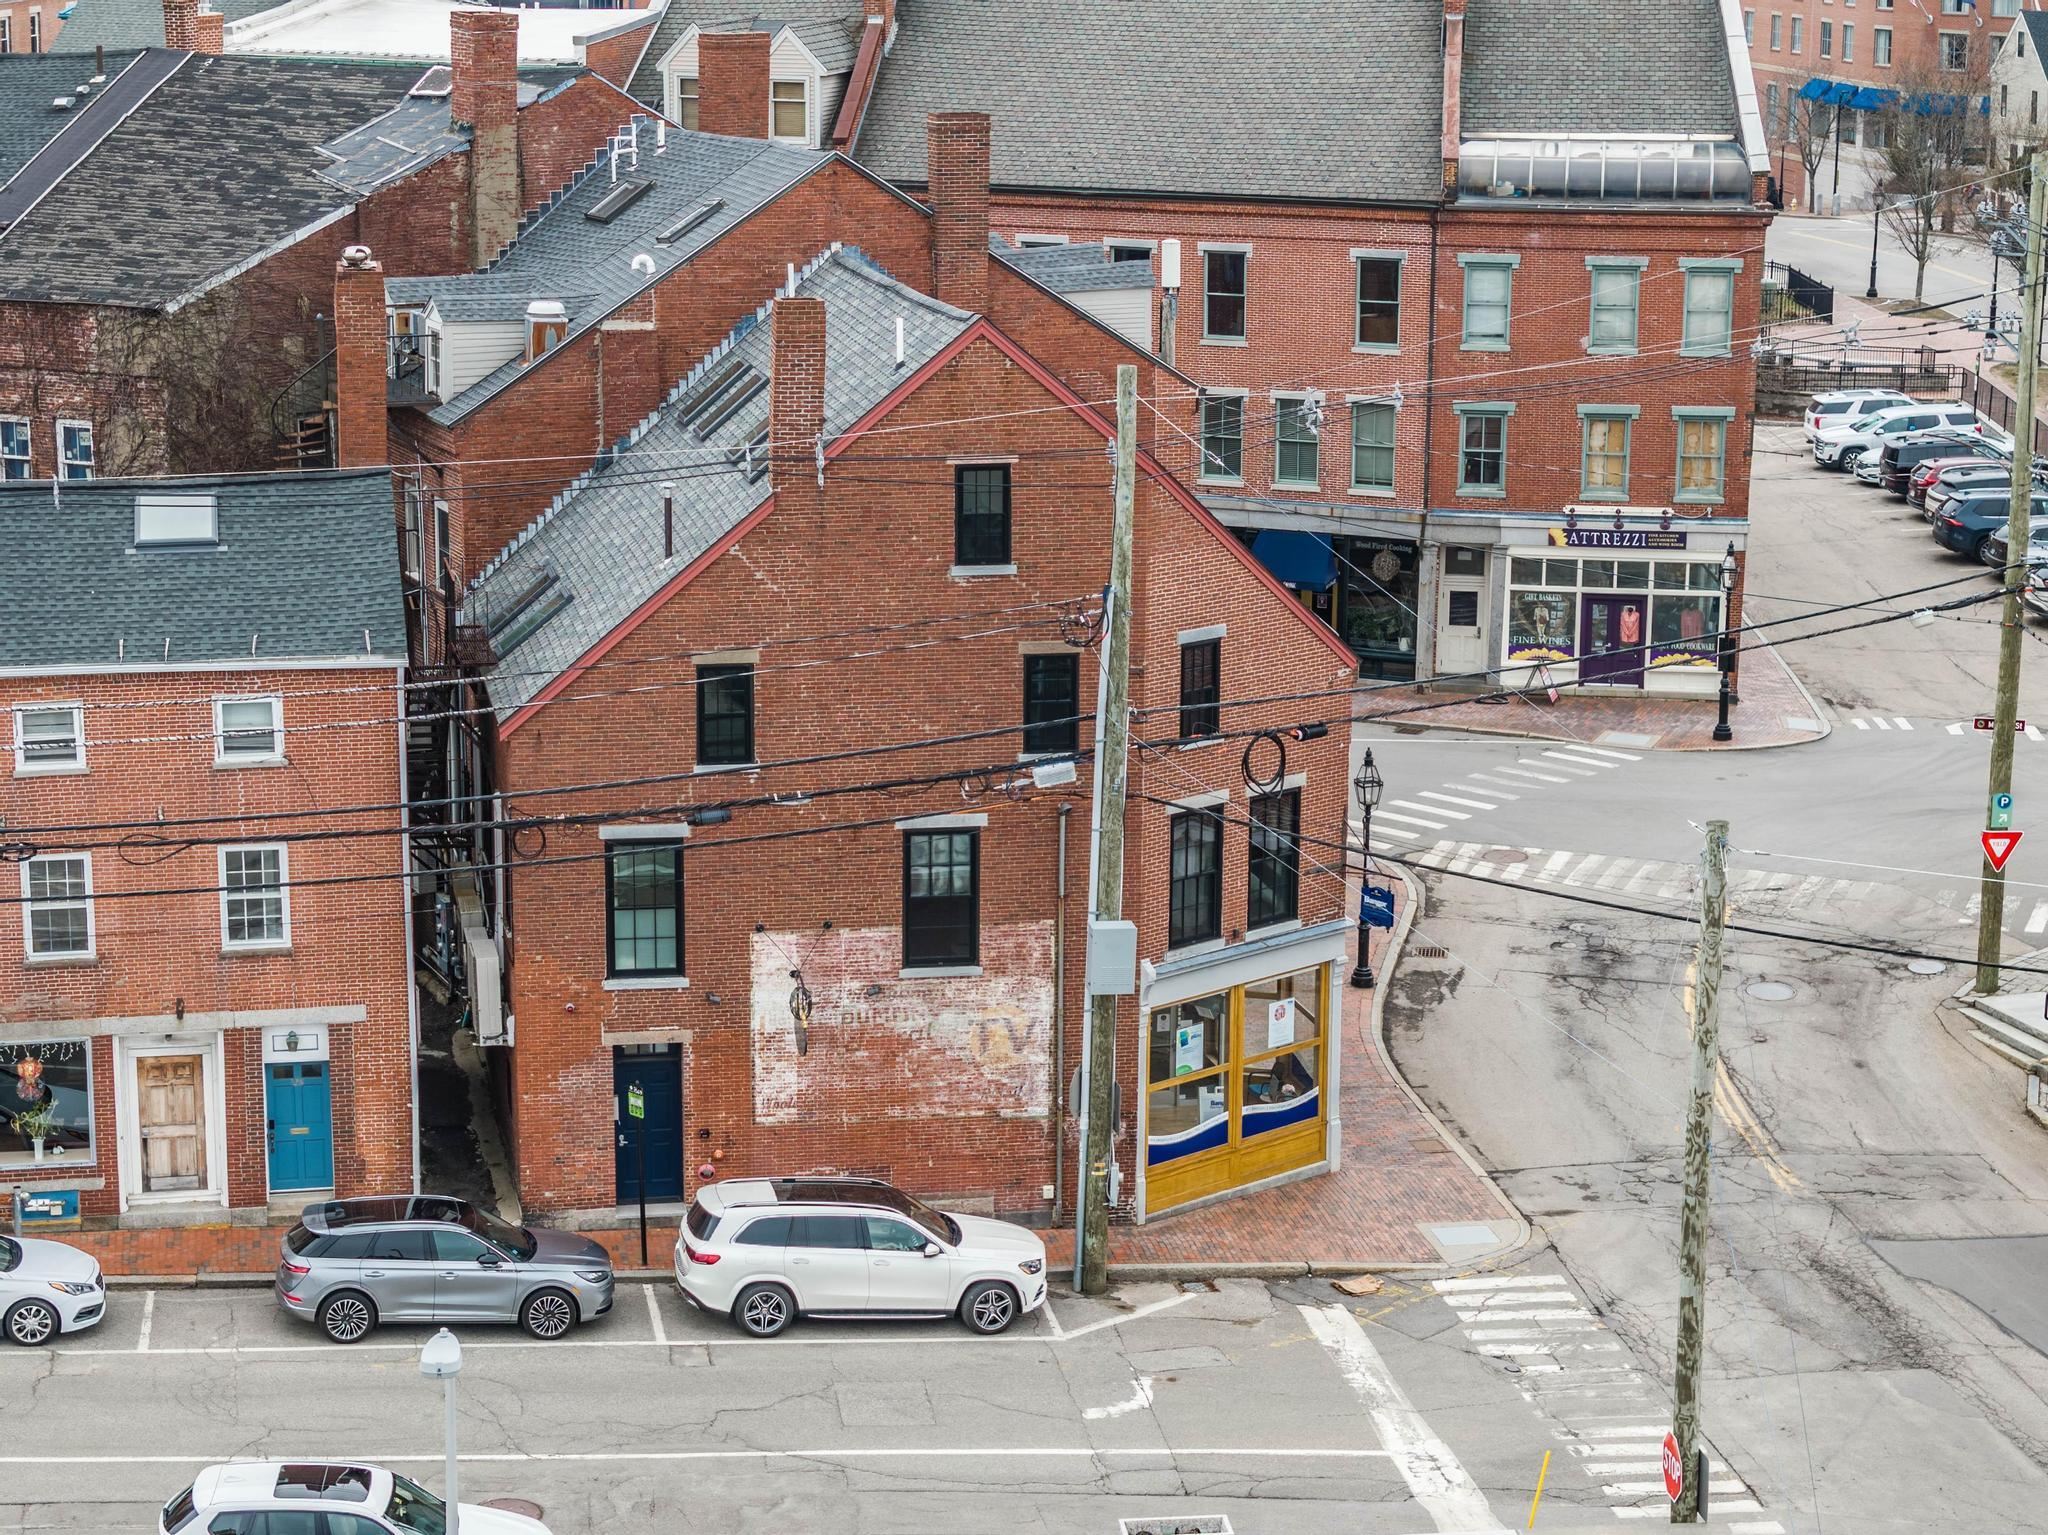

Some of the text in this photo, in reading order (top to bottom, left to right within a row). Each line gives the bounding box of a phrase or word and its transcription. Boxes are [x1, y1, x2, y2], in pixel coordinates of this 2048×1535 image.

[1569, 532, 1646, 546] ATTREZZI
[1389, 543, 1412, 553] Cooking
[1513, 635, 1571, 646] FINE WINES
[1687, 642, 1715, 651] COOKWARE
[2001, 796, 2010, 807] P
[1664, 1446, 1681, 1484] STOP
